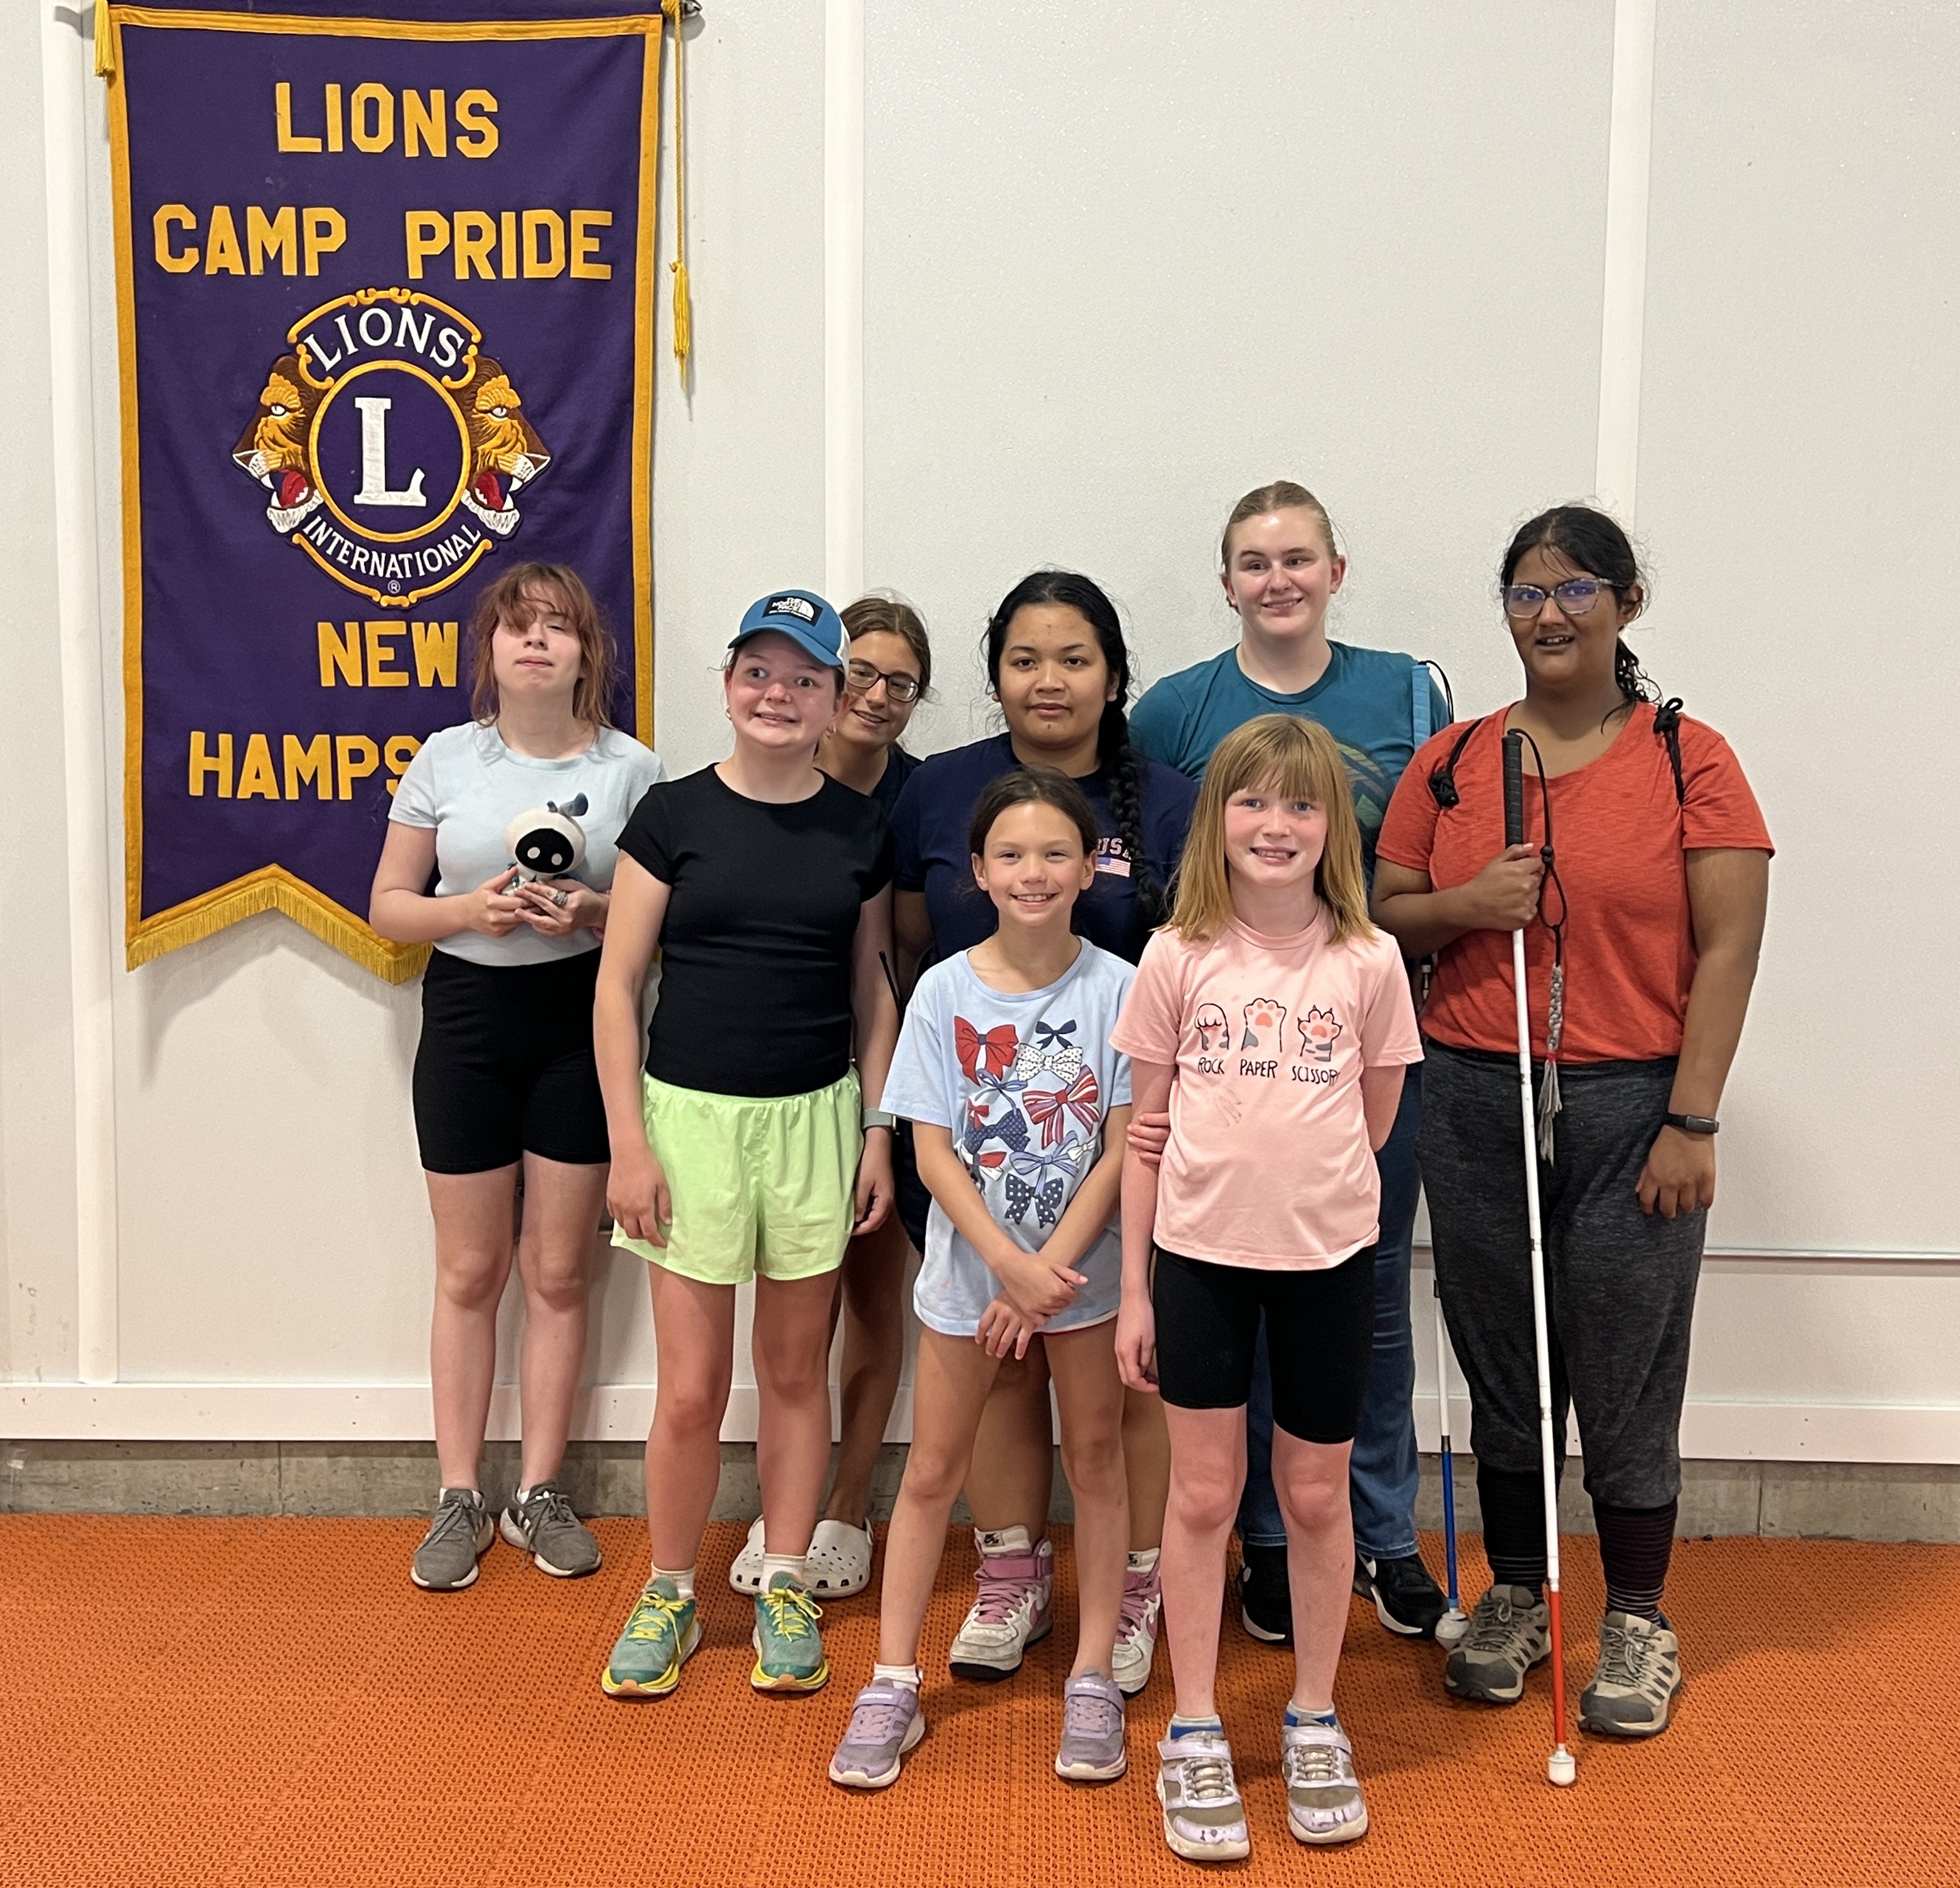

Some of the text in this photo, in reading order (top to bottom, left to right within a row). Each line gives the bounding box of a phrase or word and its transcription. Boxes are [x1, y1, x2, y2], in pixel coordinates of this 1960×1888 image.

[275, 82, 499, 158] LIONS
[153, 204, 613, 280] CAMP PRIDE
[303, 307, 465, 372] LIONS
[353, 396, 427, 508] L
[302, 515, 481, 579] INTERNATIONAL
[317, 621, 458, 687] NEW
[1198, 1056, 1225, 1075] ROCK
[1239, 1059, 1278, 1078] PAPER
